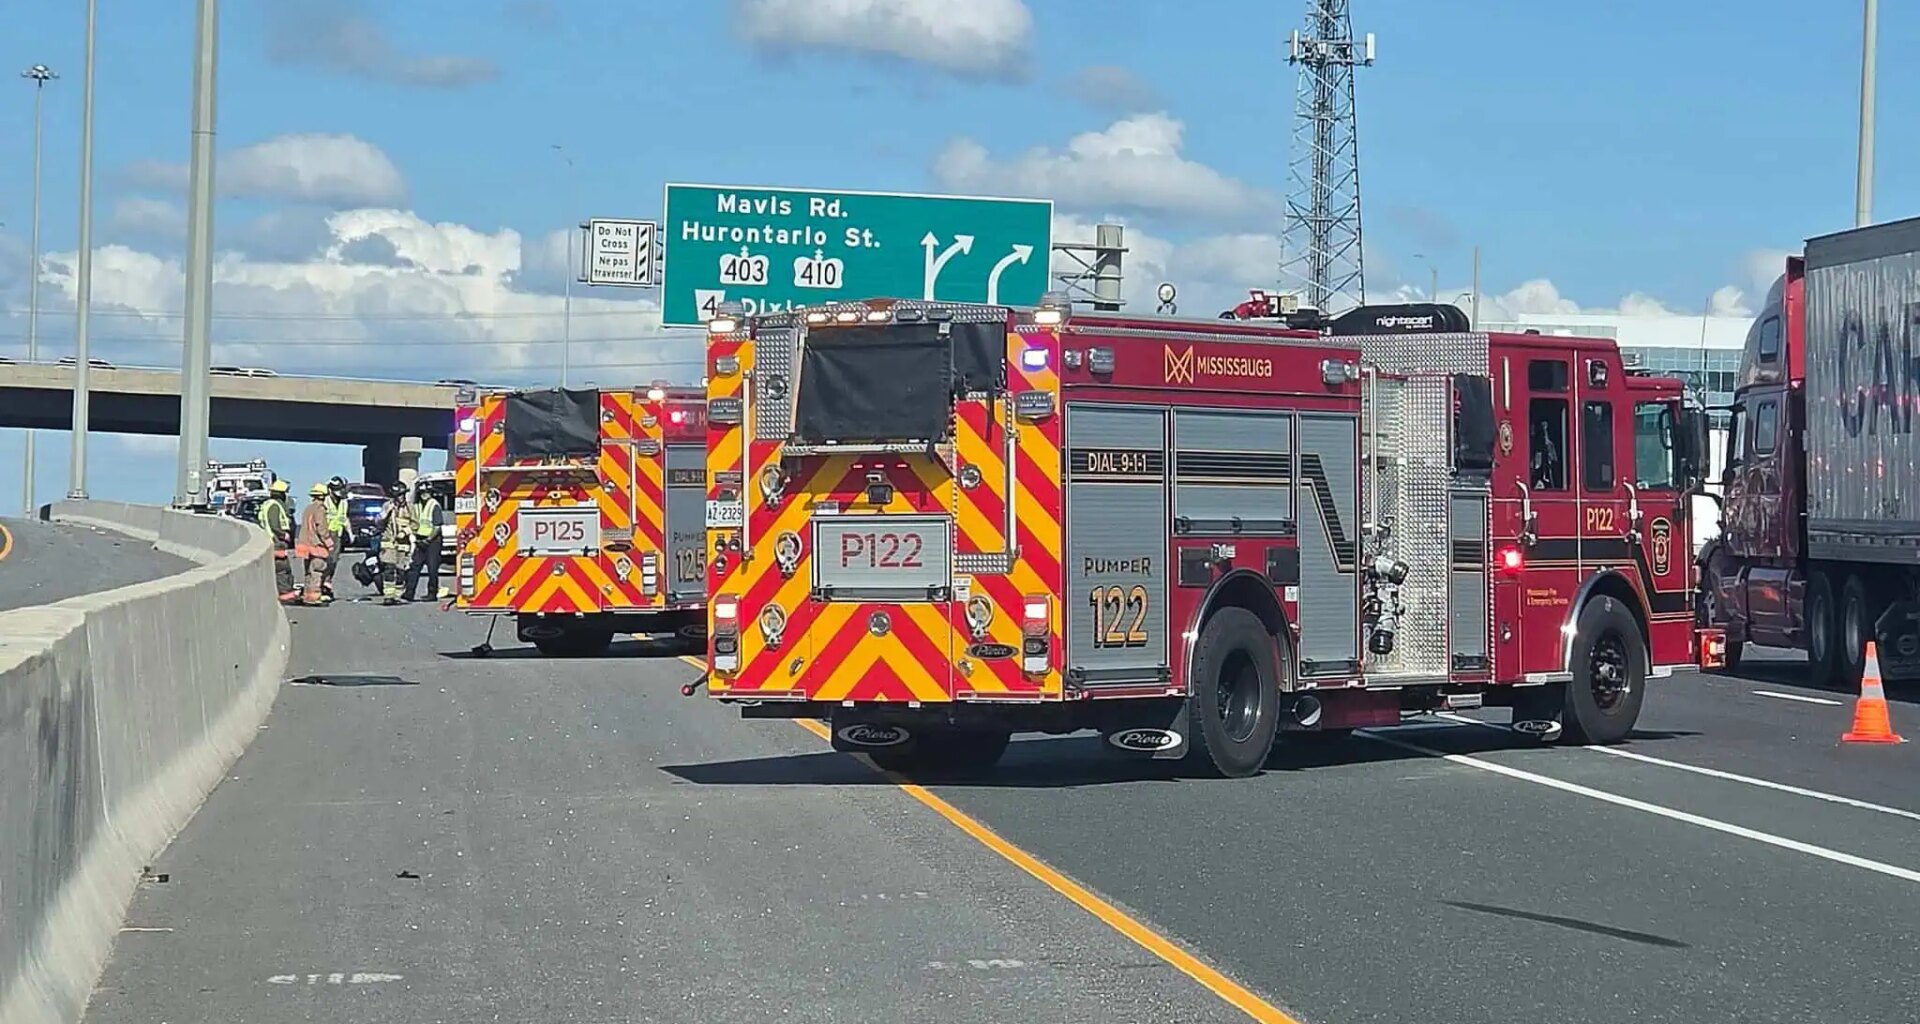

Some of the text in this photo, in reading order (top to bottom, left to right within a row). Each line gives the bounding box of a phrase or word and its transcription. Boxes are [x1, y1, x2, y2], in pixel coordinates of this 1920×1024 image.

[717, 193, 849, 218] Mavis Rd.
[598, 226, 632, 237] Do Not
[681, 220, 881, 248] Hurontario St.
[601, 238, 628, 249] Cross
[599, 256, 629, 268] Ne pas
[724, 258, 765, 282] 403
[594, 269, 633, 279] traverser
[800, 262, 837, 285] 410
[702, 295, 716, 317] 4
[1087, 452, 1147, 473] DIAL 9-1-1
[1586, 507, 1614, 531] P122
[534, 521, 585, 541] P125
[841, 532, 923, 568] P122
[675, 548, 706, 584] 125
[1084, 557, 1152, 577] PUMPER
[1089, 584, 1149, 649] 122
[849, 727, 898, 741] Pierce
[1122, 731, 1171, 747] Pierce
